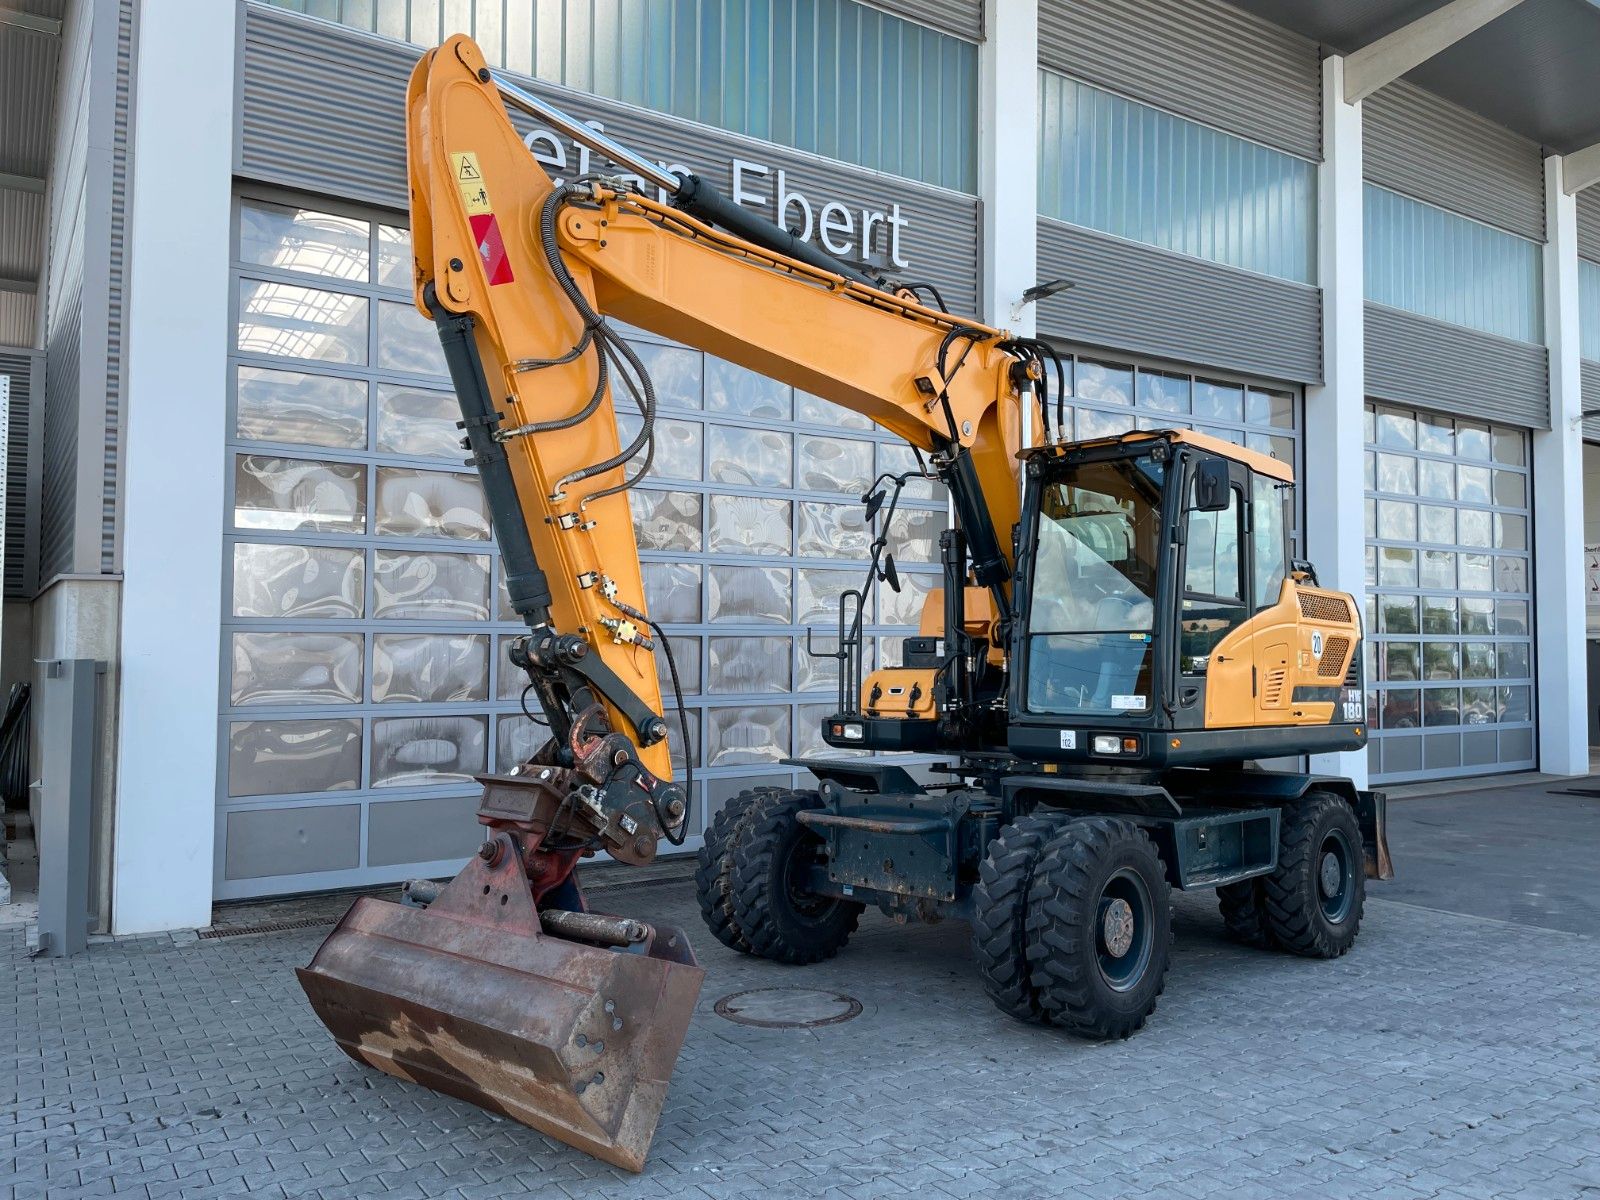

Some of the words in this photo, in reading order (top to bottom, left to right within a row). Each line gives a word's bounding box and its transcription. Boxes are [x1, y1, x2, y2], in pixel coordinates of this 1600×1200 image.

[733, 158, 909, 268] Ebert
[1312, 635, 1321, 654] 20
[1342, 702, 1362, 720] 180
